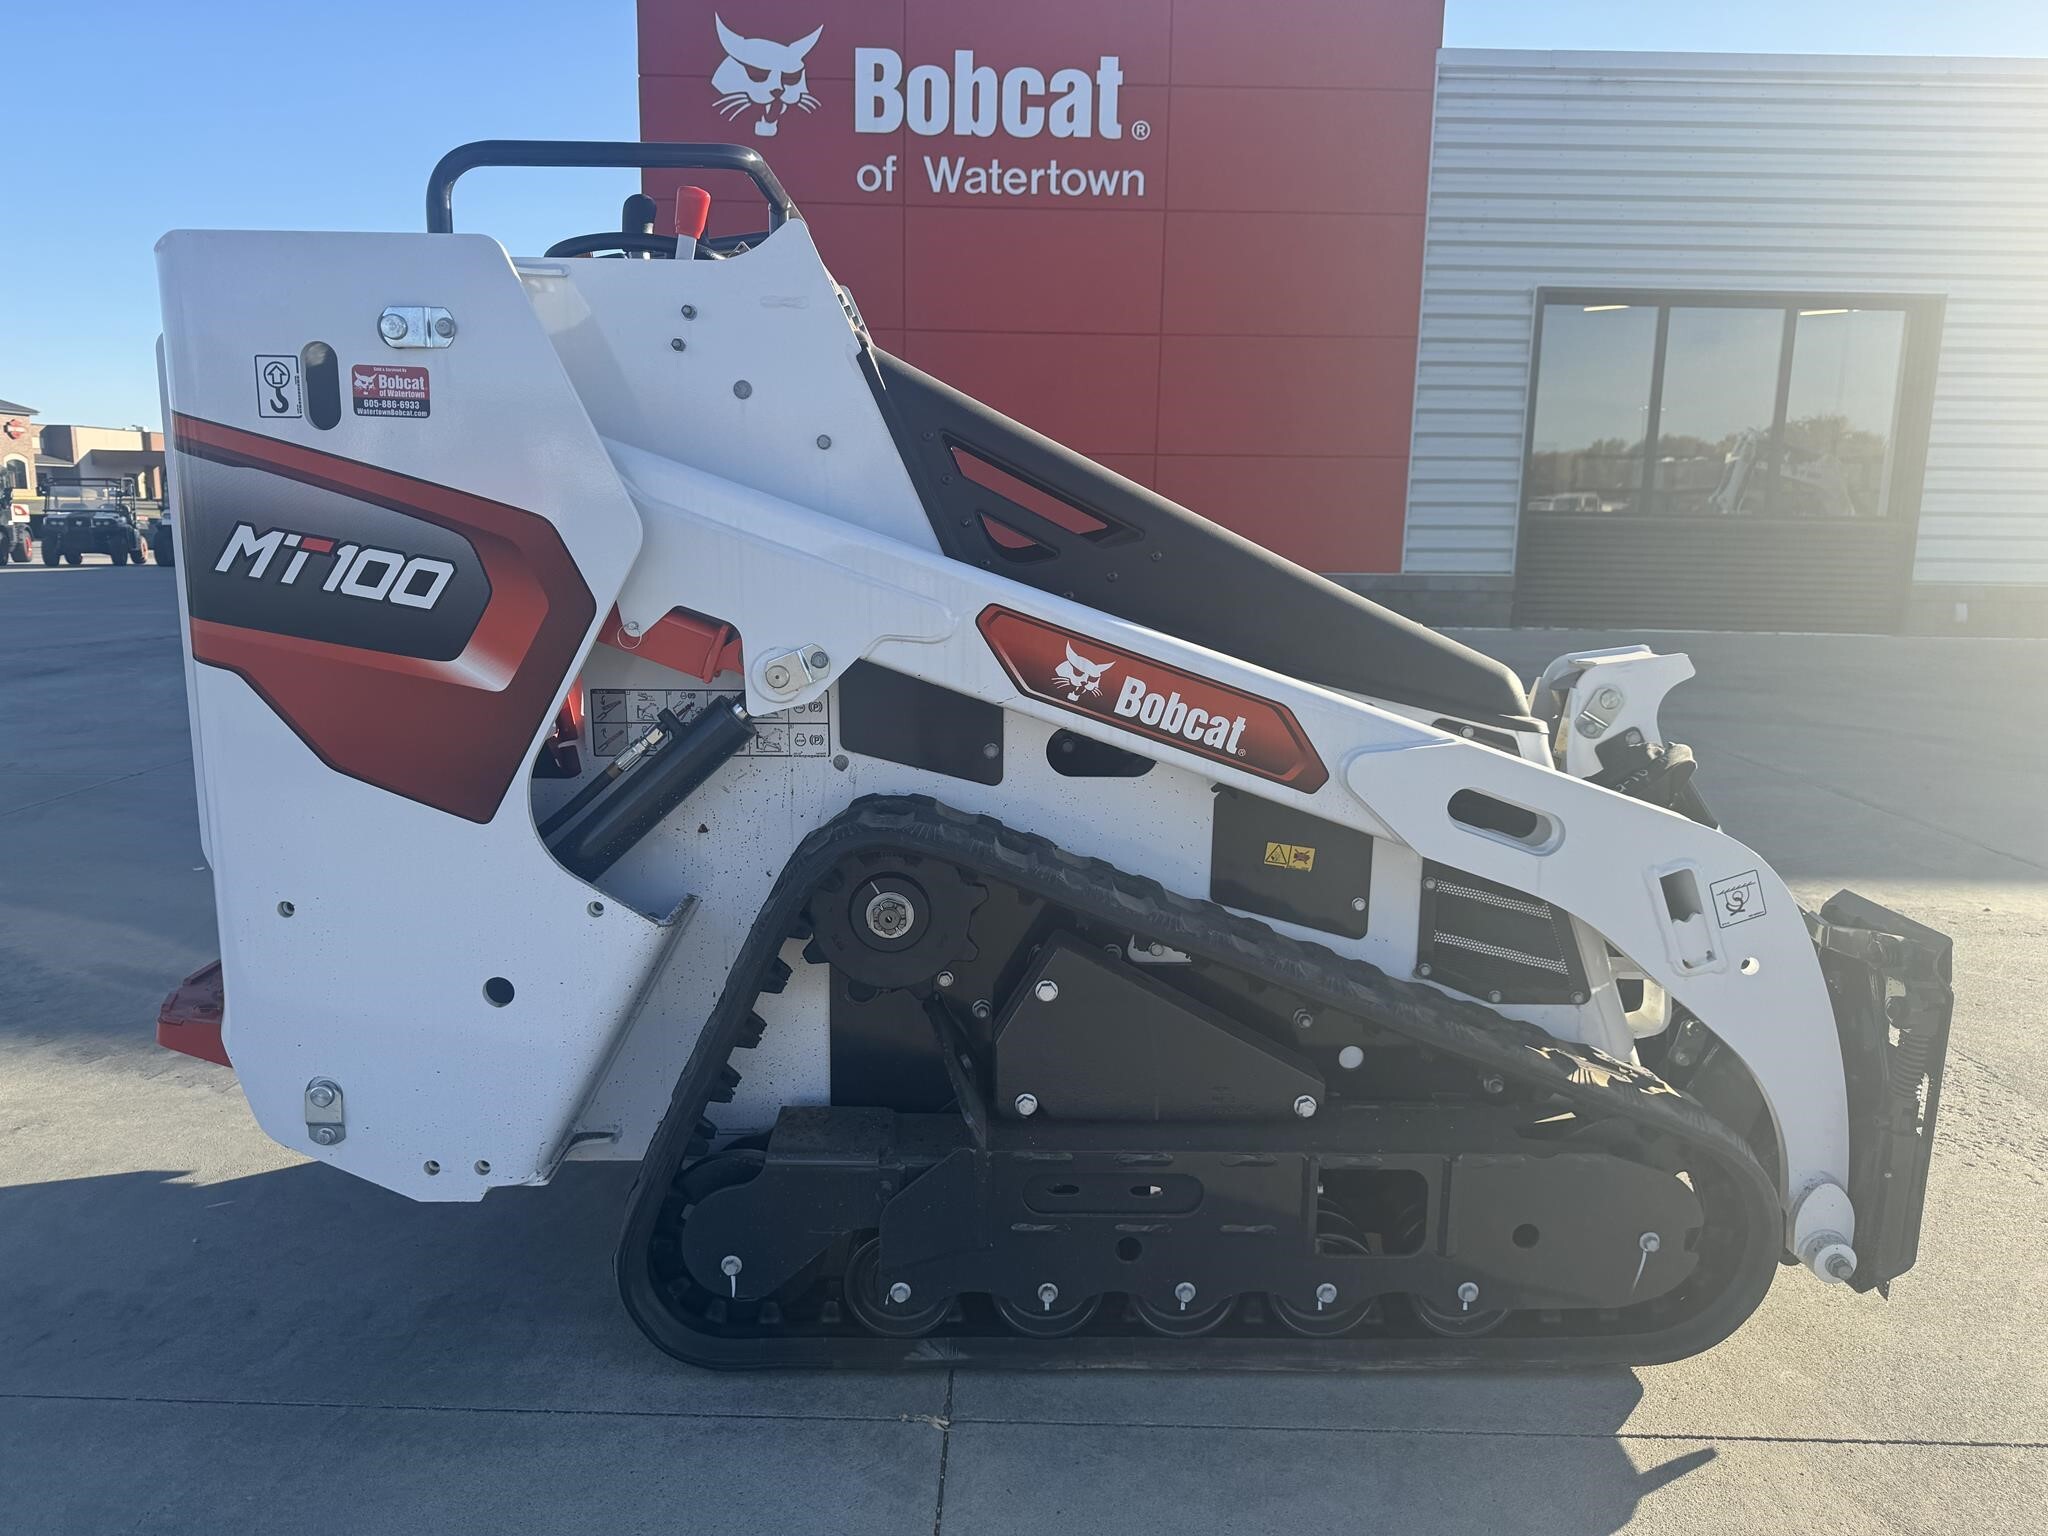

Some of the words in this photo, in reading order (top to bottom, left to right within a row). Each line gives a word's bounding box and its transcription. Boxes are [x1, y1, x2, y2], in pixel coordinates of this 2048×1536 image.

[854, 47, 1124, 140] Bobcat
[856, 155, 898, 192] of
[923, 155, 1145, 197] Watertown
[378, 374, 425, 390] Bobcat
[379, 389, 387, 397] of
[387, 389, 425, 398] Watertown
[356, 408, 428, 417] WatertownBobcat.com
[363, 399, 420, 410] 605-886-6933
[214, 524, 455, 610] MT100
[1113, 675, 1247, 755] Bobcat
